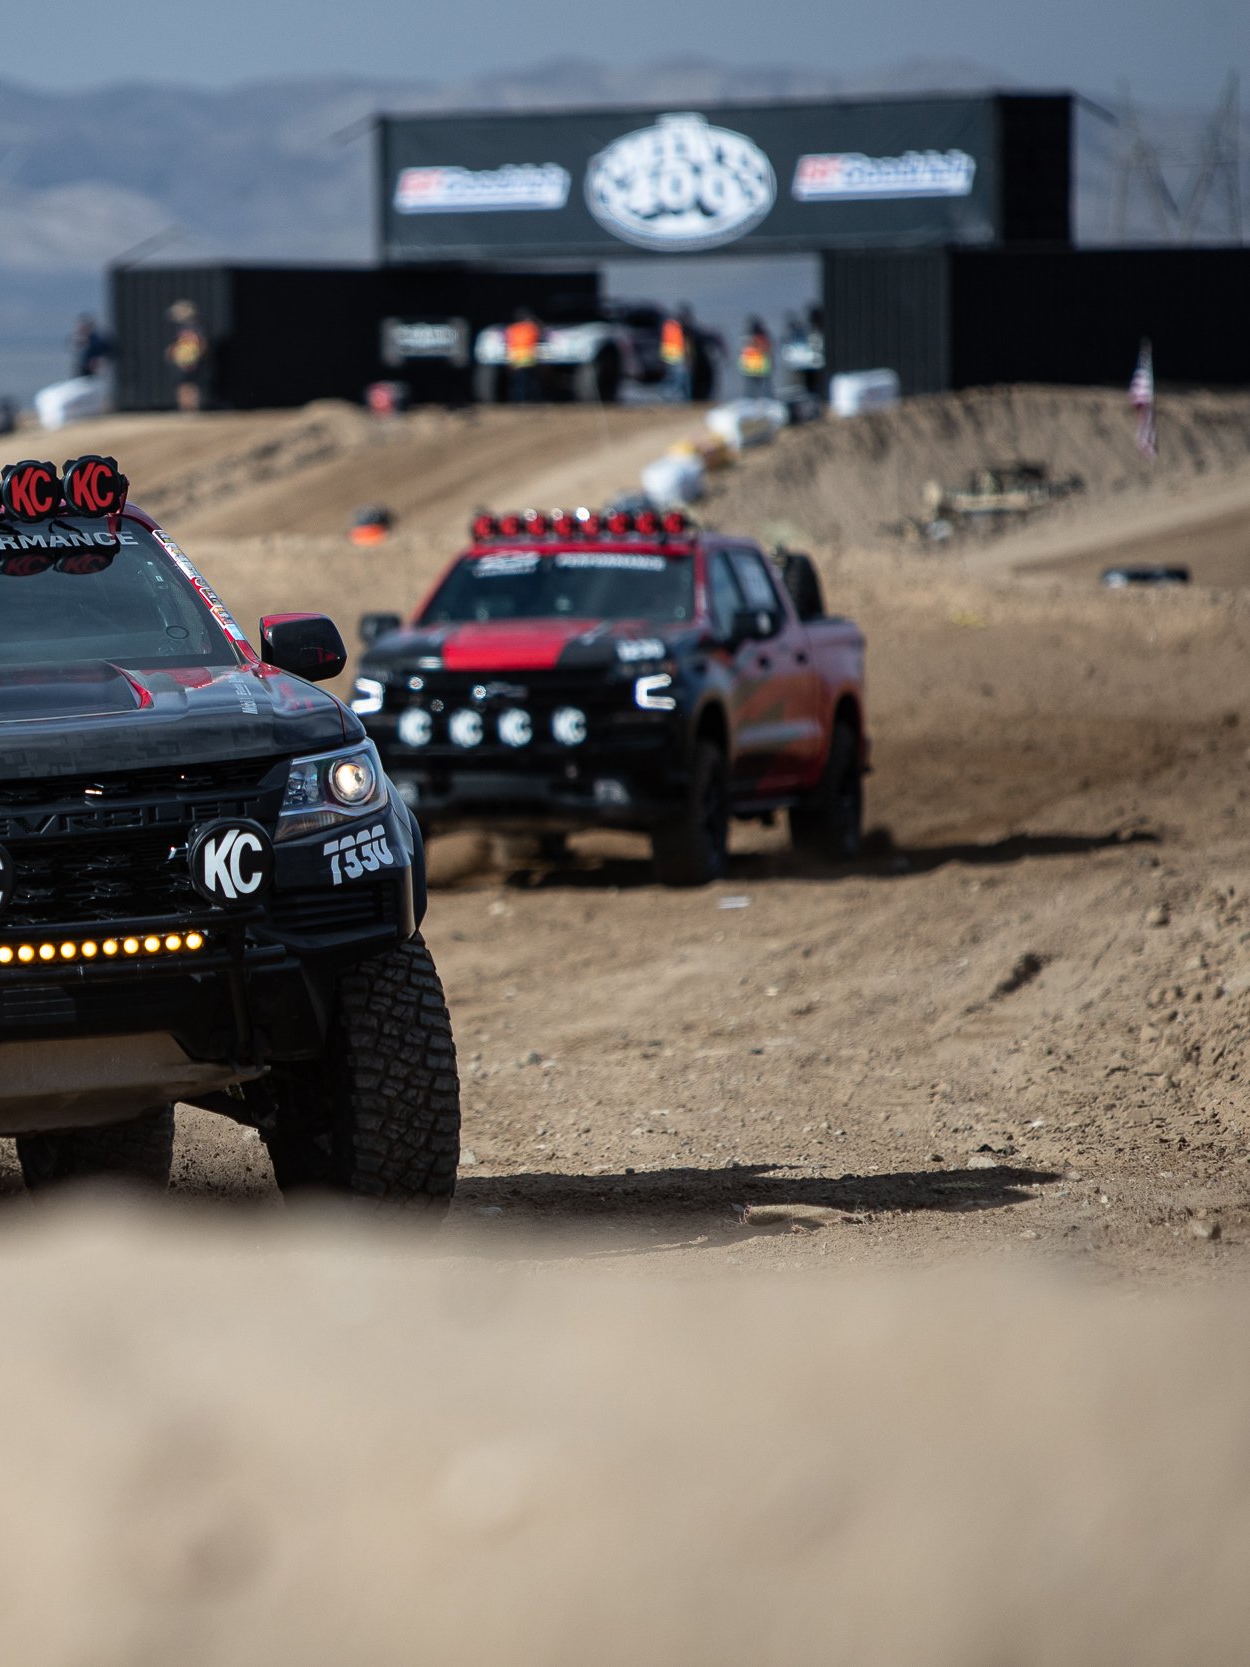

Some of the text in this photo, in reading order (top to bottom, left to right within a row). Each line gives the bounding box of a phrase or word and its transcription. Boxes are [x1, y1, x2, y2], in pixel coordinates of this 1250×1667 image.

[11, 467, 53, 517] KC
[73, 462, 115, 512] KC
[204, 829, 263, 899] KC
[323, 824, 394, 887] 7330
